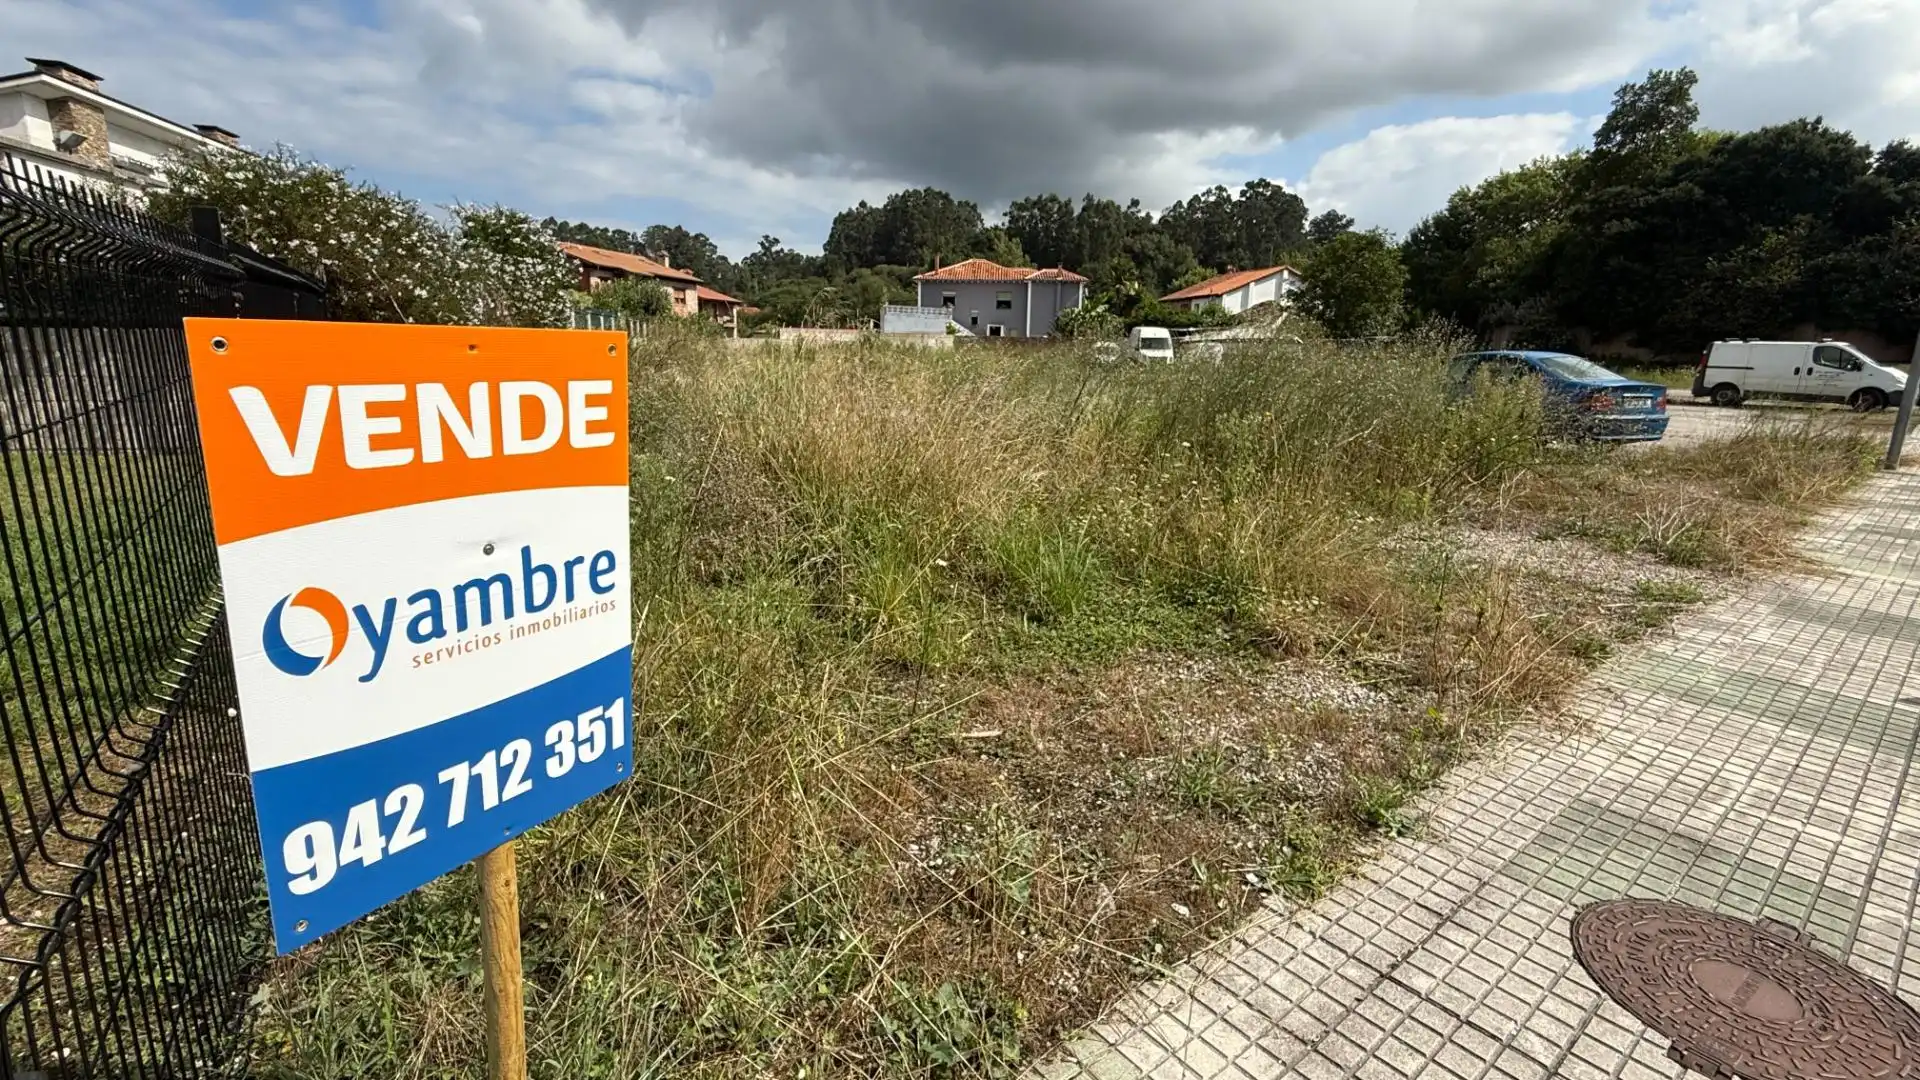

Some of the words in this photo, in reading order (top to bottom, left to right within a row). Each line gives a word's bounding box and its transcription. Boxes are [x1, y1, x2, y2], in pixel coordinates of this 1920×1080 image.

[229, 379, 615, 476] VENDE
[263, 545, 617, 683] Oyambre
[411, 630, 502, 669] servicios
[509, 599, 617, 641] inmobiliarios
[282, 783, 427, 896] 942
[437, 737, 533, 828] 712
[545, 697, 626, 779] 351
